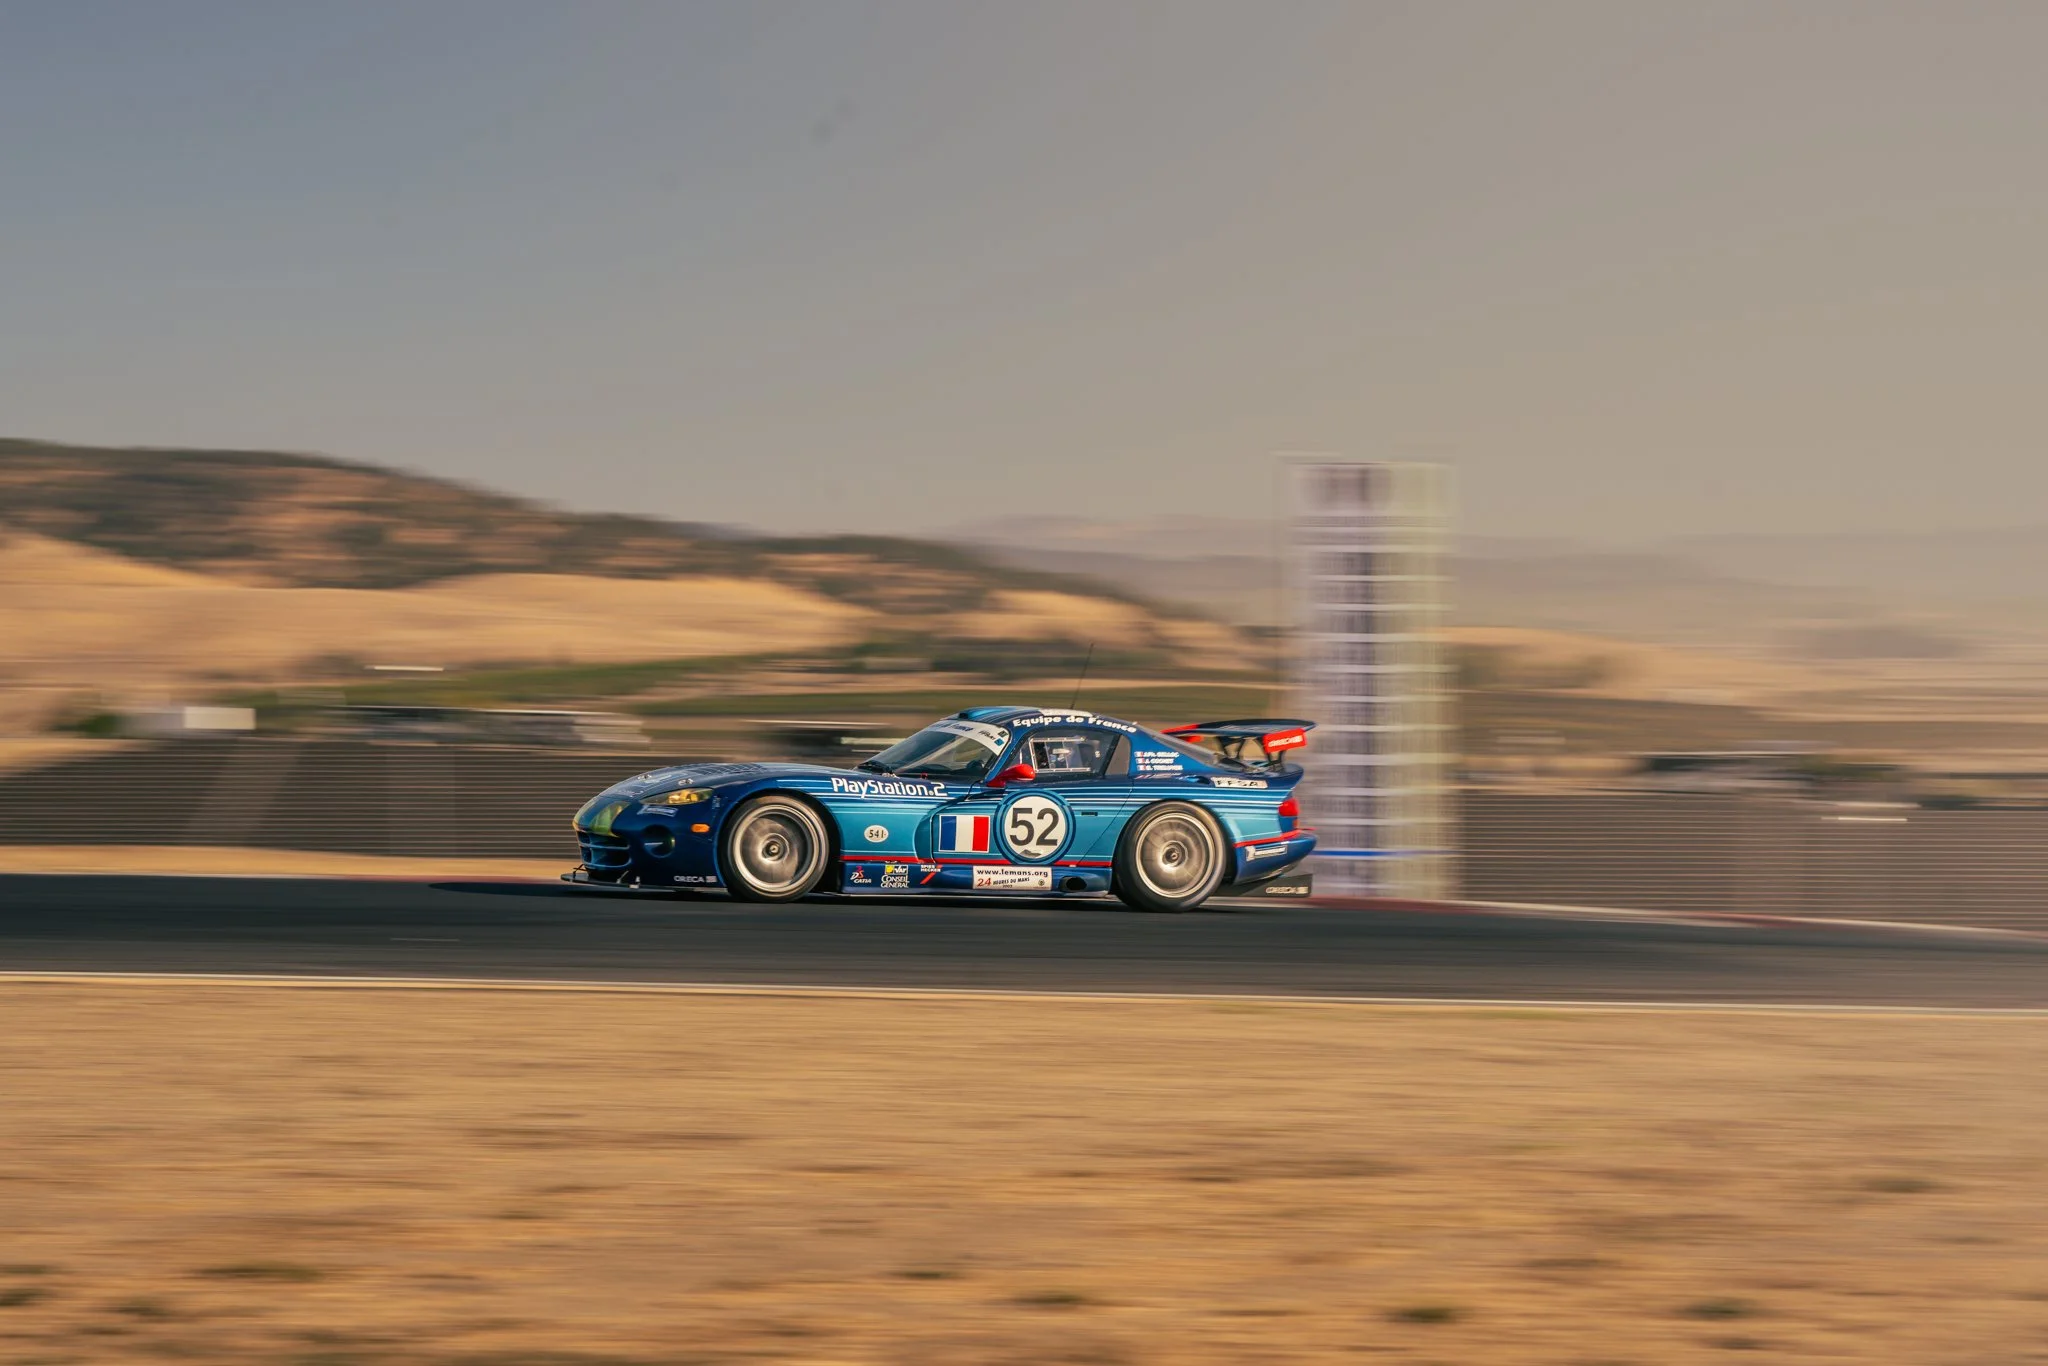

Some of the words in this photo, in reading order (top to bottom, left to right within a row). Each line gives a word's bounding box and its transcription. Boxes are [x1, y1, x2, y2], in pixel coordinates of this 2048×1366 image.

[1012, 716, 1062, 728] Equipe
[1066, 715, 1084, 723] de
[1088, 716, 1137, 733] France
[1009, 807, 1059, 847] 52
[976, 868, 1049, 877] www.lemans.org
[881, 874, 909, 883] CONSEIL
[977, 877, 992, 887] 24
